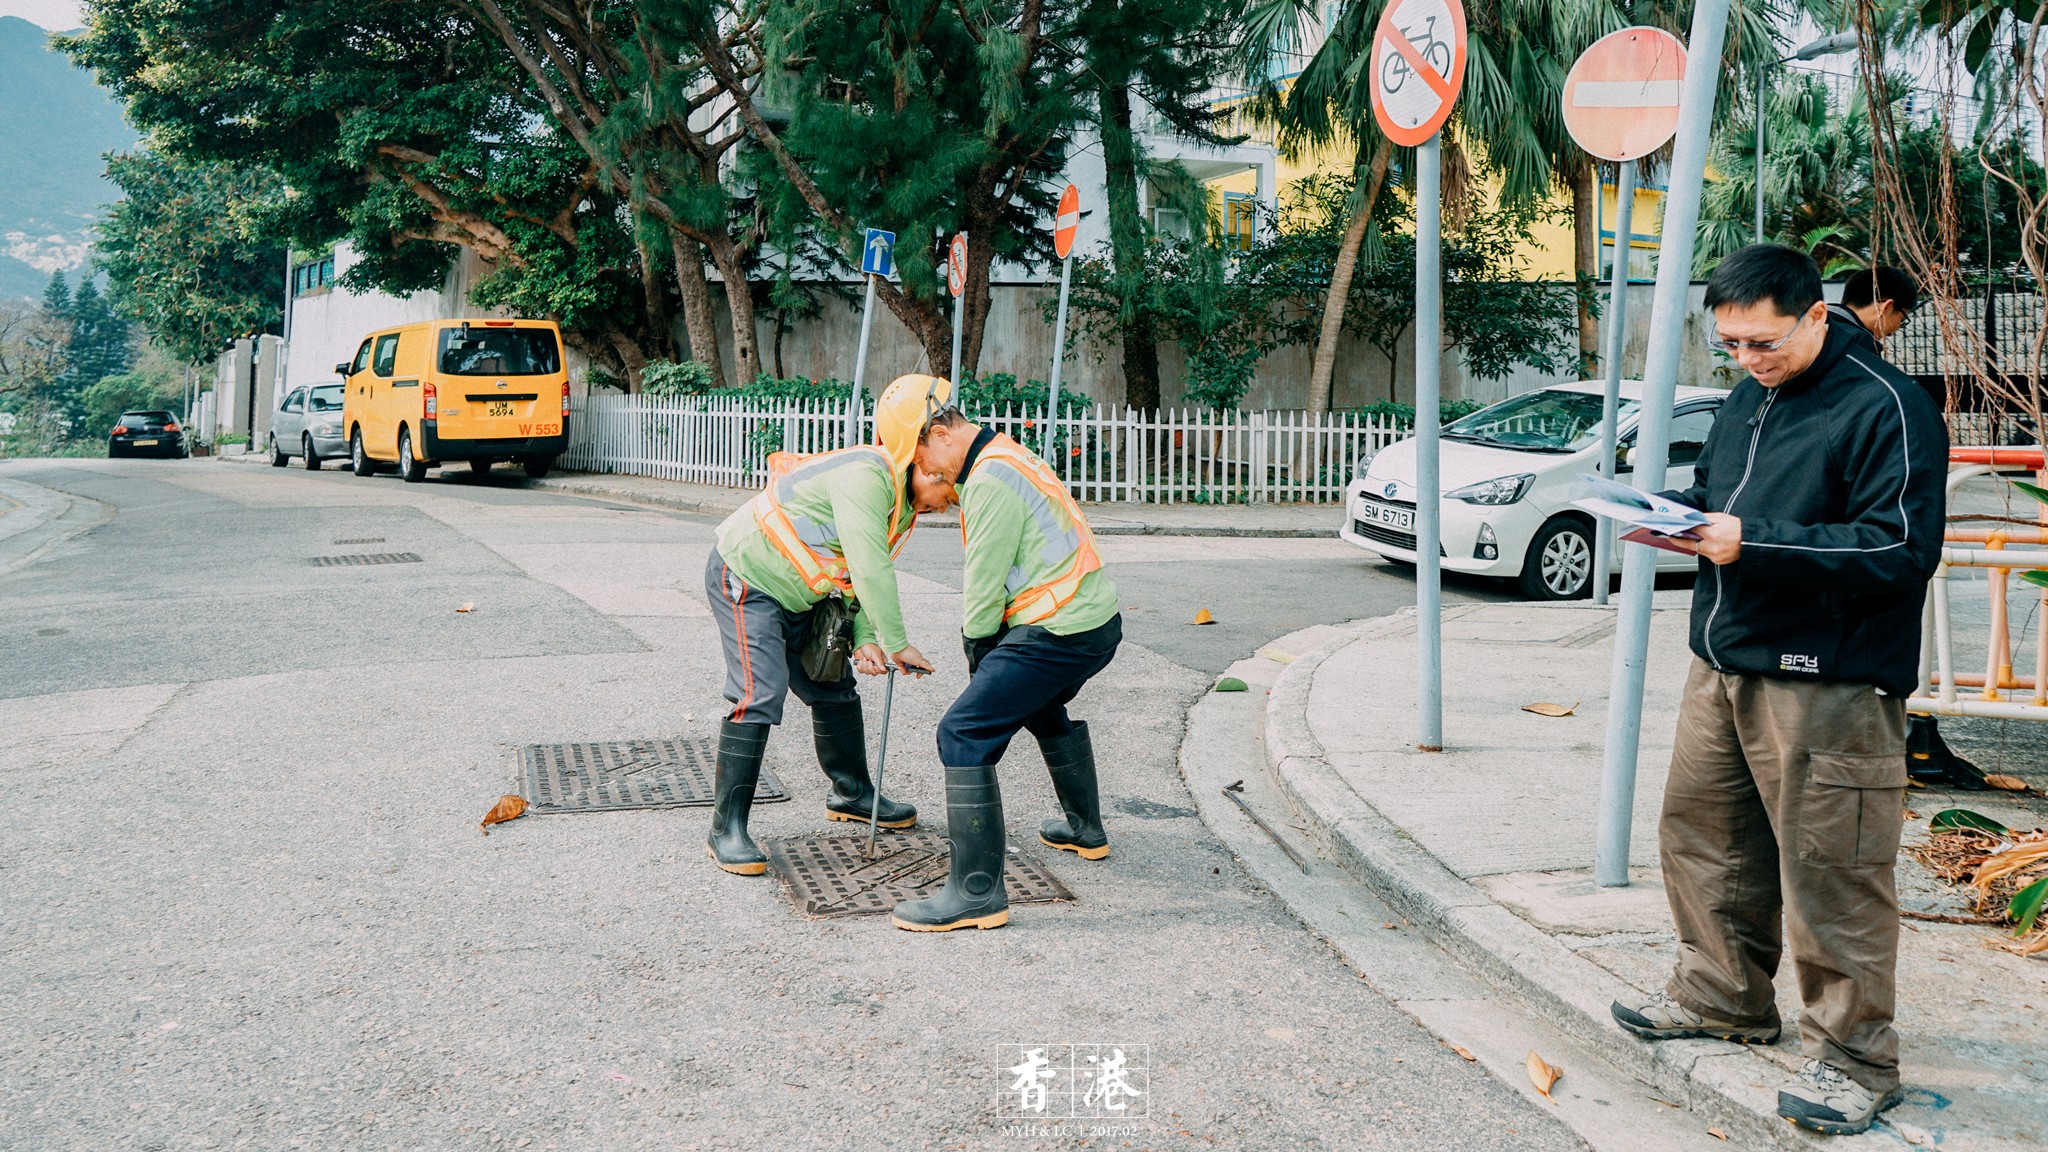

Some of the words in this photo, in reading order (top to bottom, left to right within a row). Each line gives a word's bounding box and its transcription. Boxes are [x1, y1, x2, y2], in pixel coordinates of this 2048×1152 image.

[519, 424, 532, 435] W
[535, 423, 559, 435] 553
[1364, 505, 1379, 519] SM
[1382, 509, 1408, 527] 6713
[1780, 654, 1818, 667] SPY
